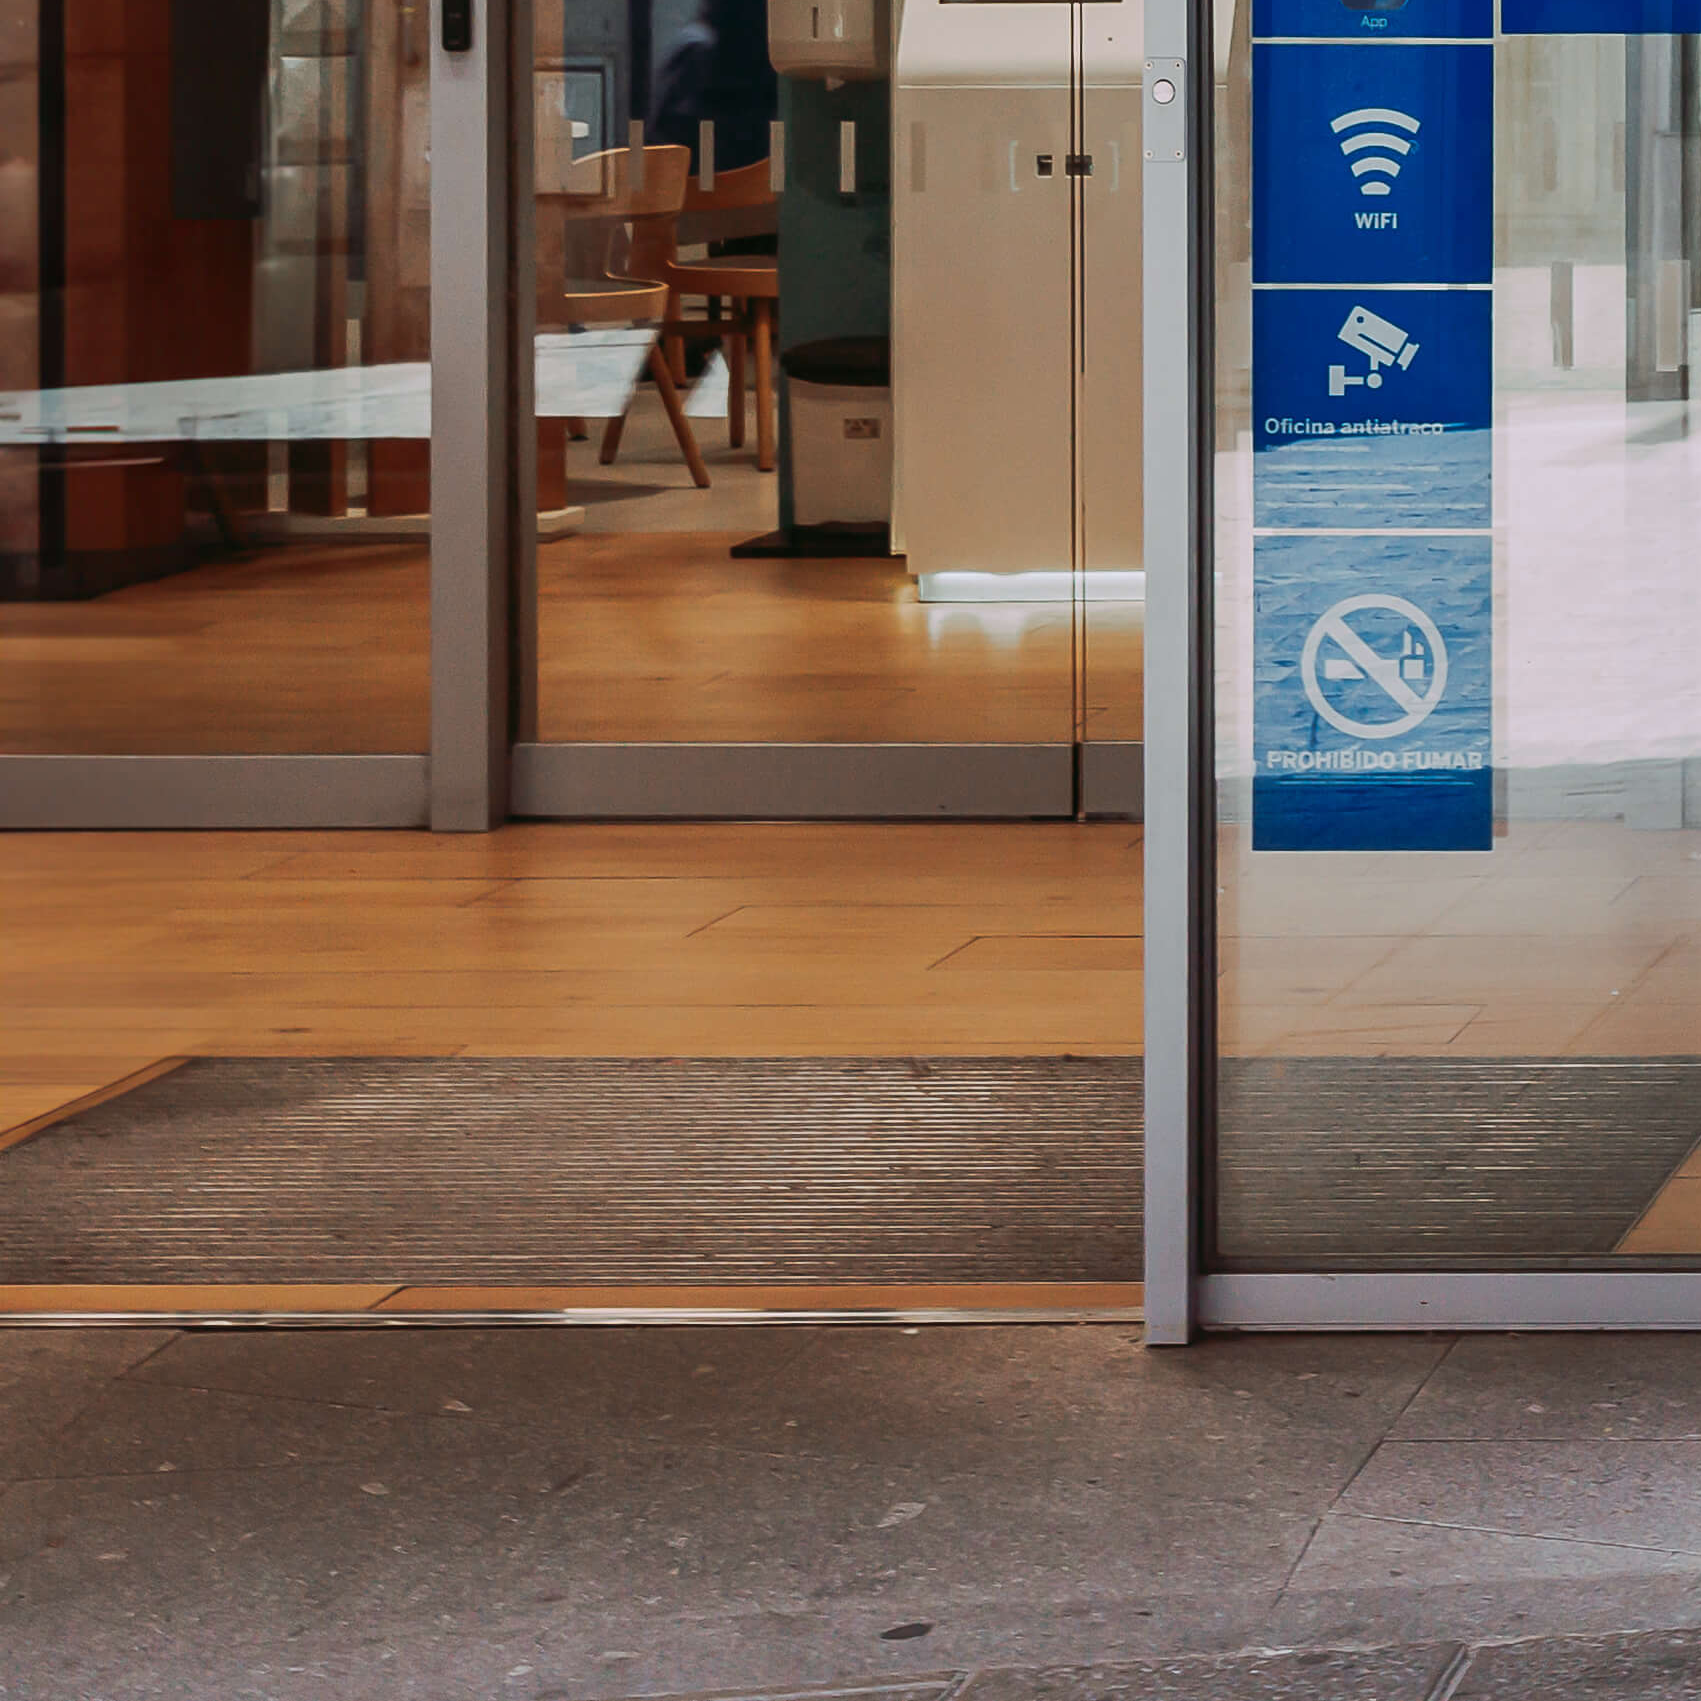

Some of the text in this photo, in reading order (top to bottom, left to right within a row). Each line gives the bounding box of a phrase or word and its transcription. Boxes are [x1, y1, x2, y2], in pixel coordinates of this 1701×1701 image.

[1360, 15, 1388, 29] App
[1354, 212, 1398, 229] WiFi
[1264, 418, 1444, 436] Oficina antiatraco
[1266, 750, 1483, 770] PROHIBIDO FUMAR
